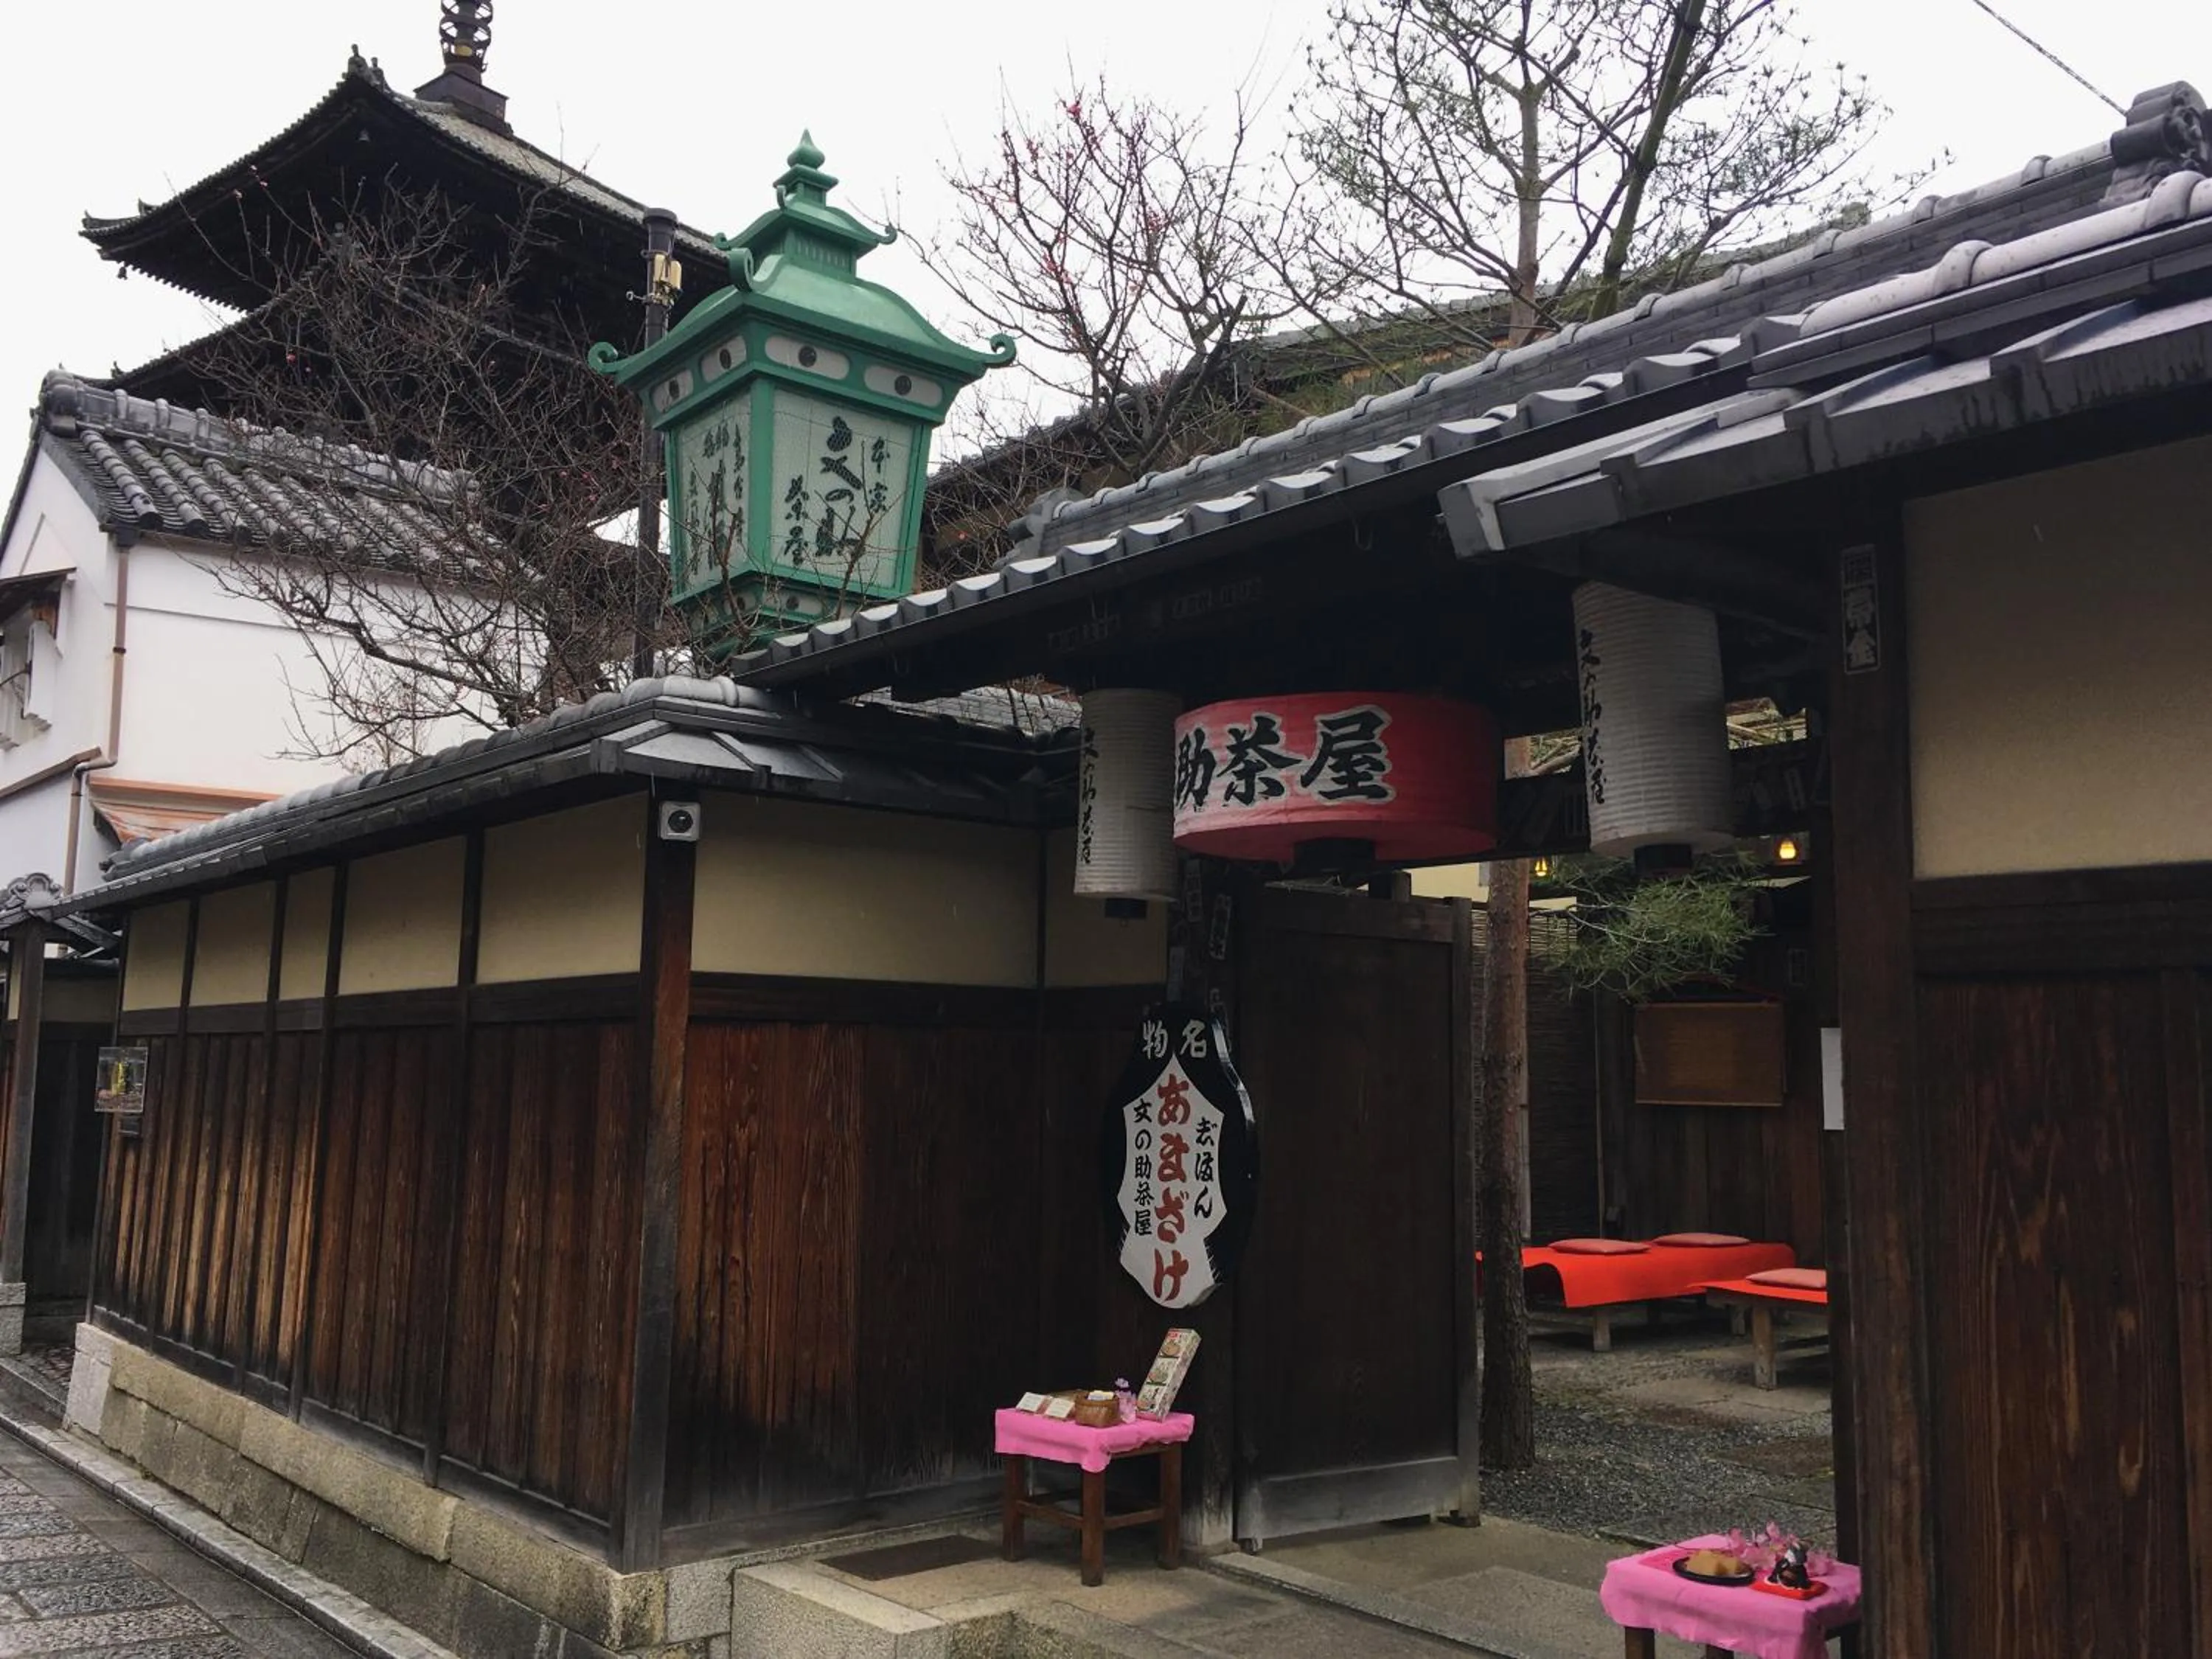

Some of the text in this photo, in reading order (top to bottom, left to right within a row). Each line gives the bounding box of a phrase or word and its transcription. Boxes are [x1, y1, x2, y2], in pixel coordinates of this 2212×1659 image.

[1175, 710, 1391, 813] 助茶屋
[1142, 1019, 1207, 1060] 名物
[1133, 1098, 1155, 1237] 文の助茶屋
[1153, 1073, 1191, 1302] あまざけ
